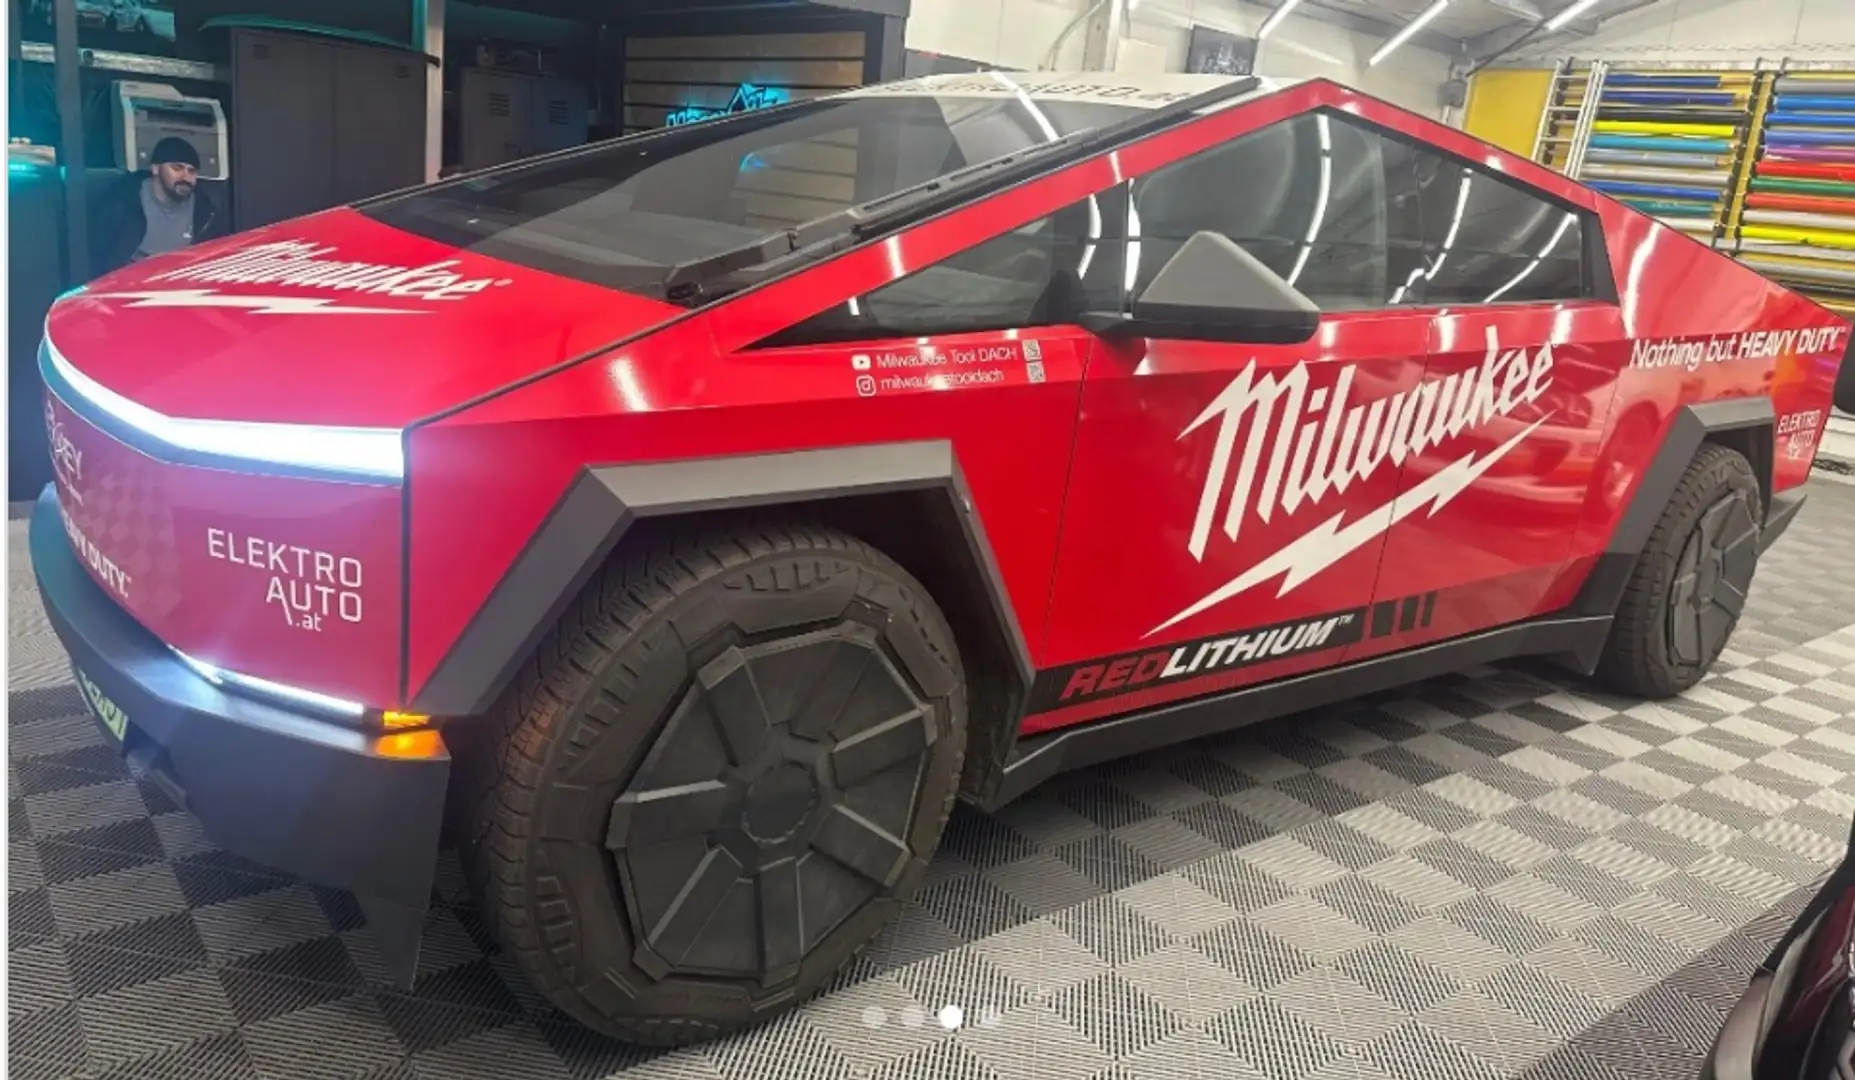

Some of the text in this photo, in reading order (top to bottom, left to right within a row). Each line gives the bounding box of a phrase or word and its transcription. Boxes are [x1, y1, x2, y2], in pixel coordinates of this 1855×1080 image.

[952, 349, 976, 364] Tool
[978, 347, 1018, 362] DACH
[1629, 336, 1704, 371] Nothing
[1706, 334, 1737, 362] but
[1736, 329, 1798, 358] HEAVY
[881, 368, 1004, 390] milwauketooldach
[207, 526, 362, 588] ELEKTRO
[265, 576, 362, 626] AUTO
